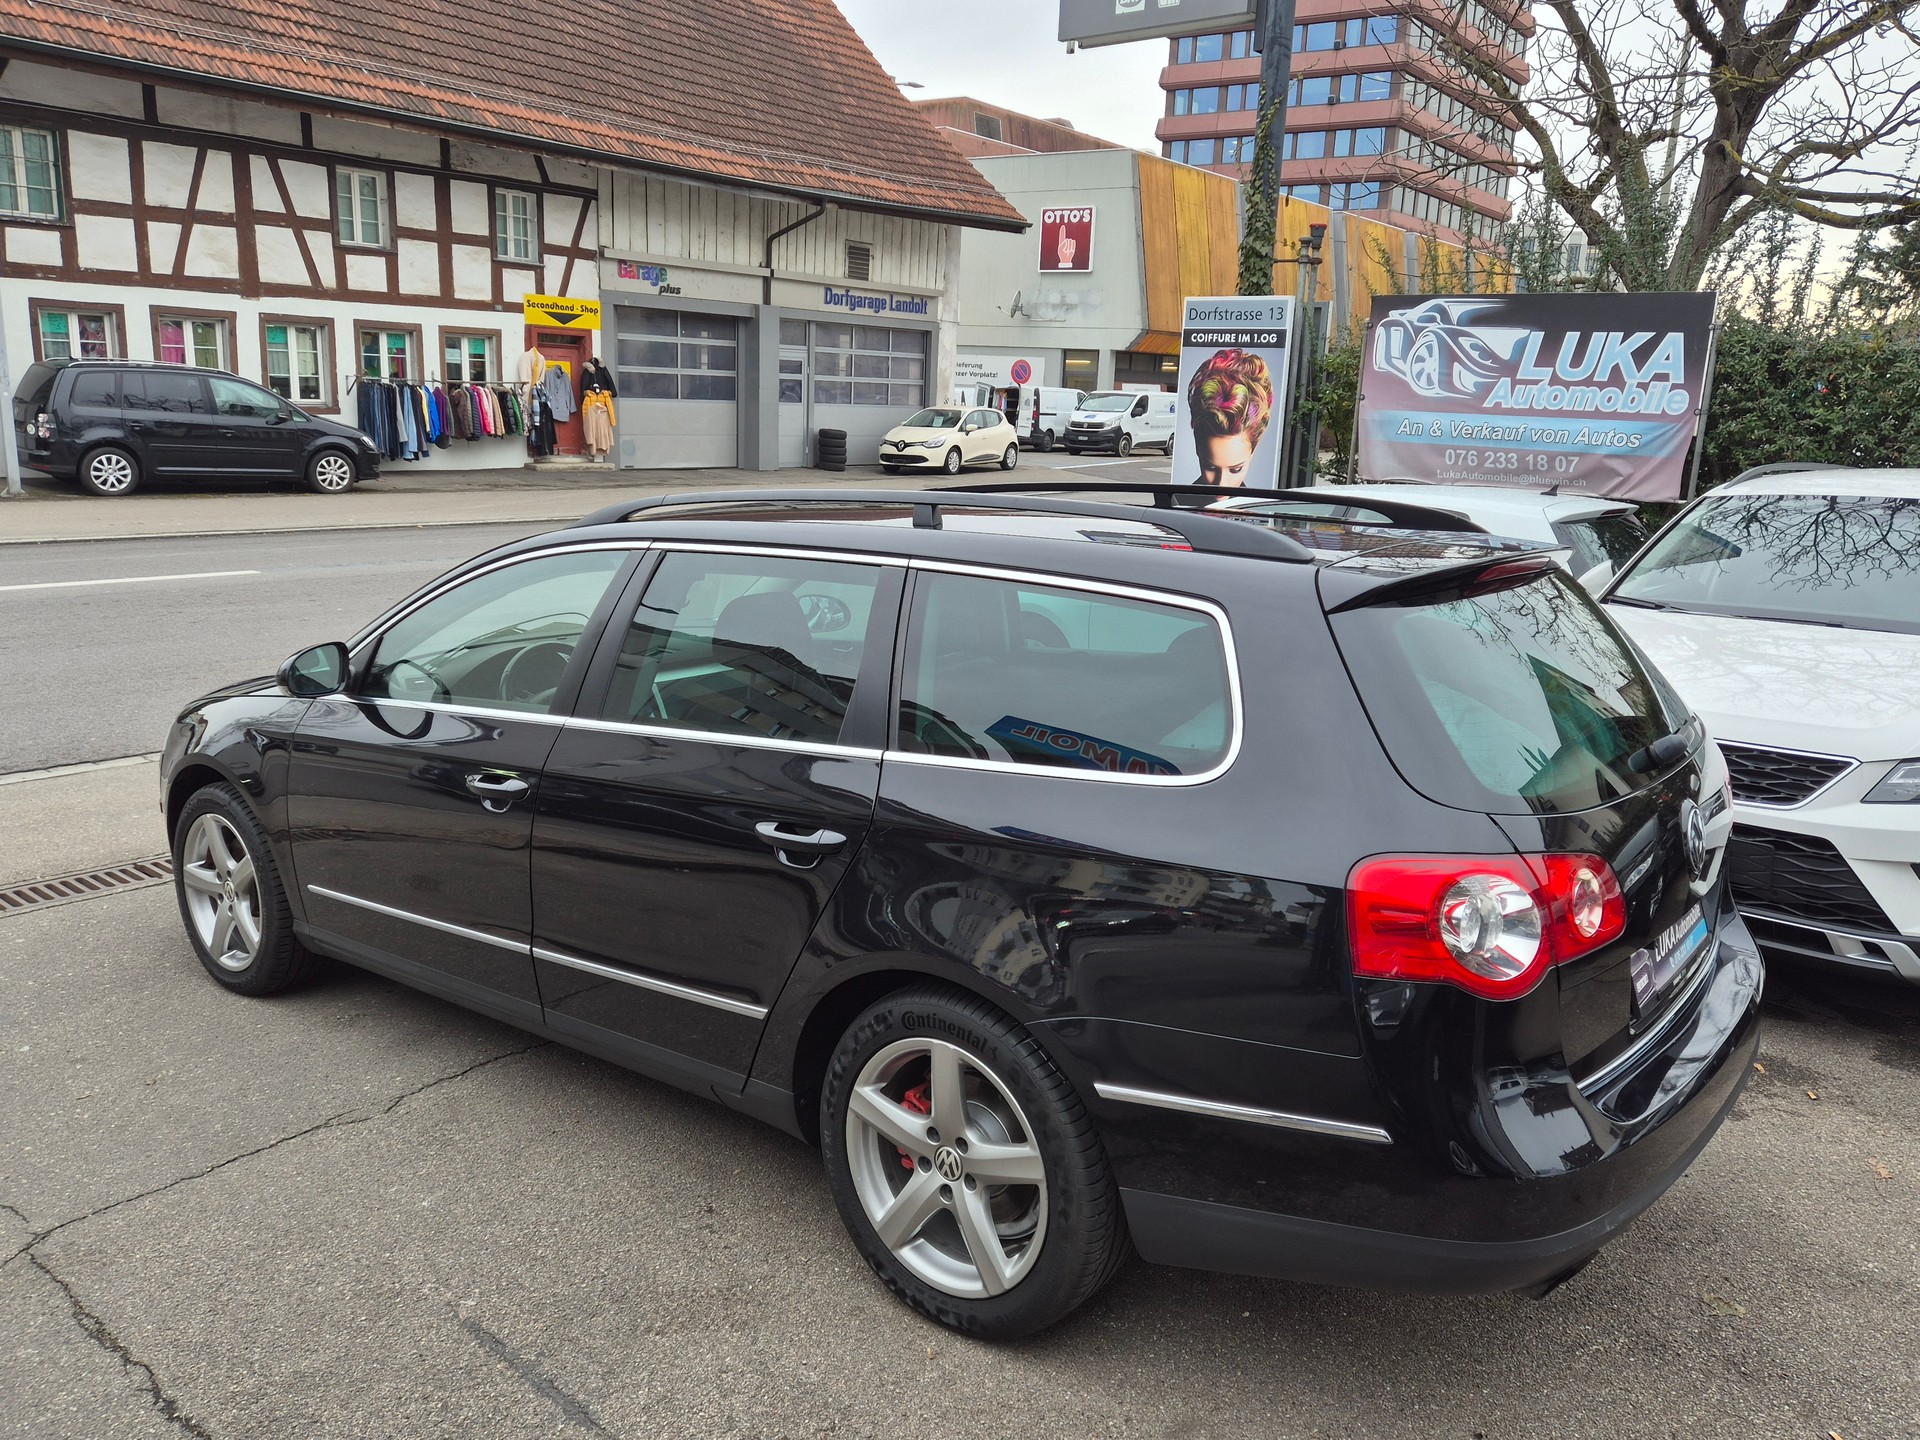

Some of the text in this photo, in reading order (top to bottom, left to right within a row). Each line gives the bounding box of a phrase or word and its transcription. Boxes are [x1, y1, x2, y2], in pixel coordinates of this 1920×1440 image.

[1044, 209, 1091, 224] OTTO'S
[617, 259, 667, 287] Garage
[658, 284, 681, 296] plus
[824, 287, 928, 315] Dorfgarage Landolt
[526, 300, 575, 312] Secondhand
[580, 305, 599, 317] Shop
[1188, 307, 1284, 321] Dorfstrasse 13
[1191, 333, 1236, 343] COIFFURE
[1238, 333, 1251, 343] IM
[1516, 331, 1685, 384] LUKA
[1482, 377, 1690, 415] Automobile
[1396, 418, 1642, 448] An & Verkauf von Autos
[1445, 449, 1580, 473] 076 233 18 07
[1437, 469, 1586, 487] LukaAutomobile@bluewin.ch
[1655, 926, 1676, 962] LUKA
[901, 1010, 988, 1054] Continental
